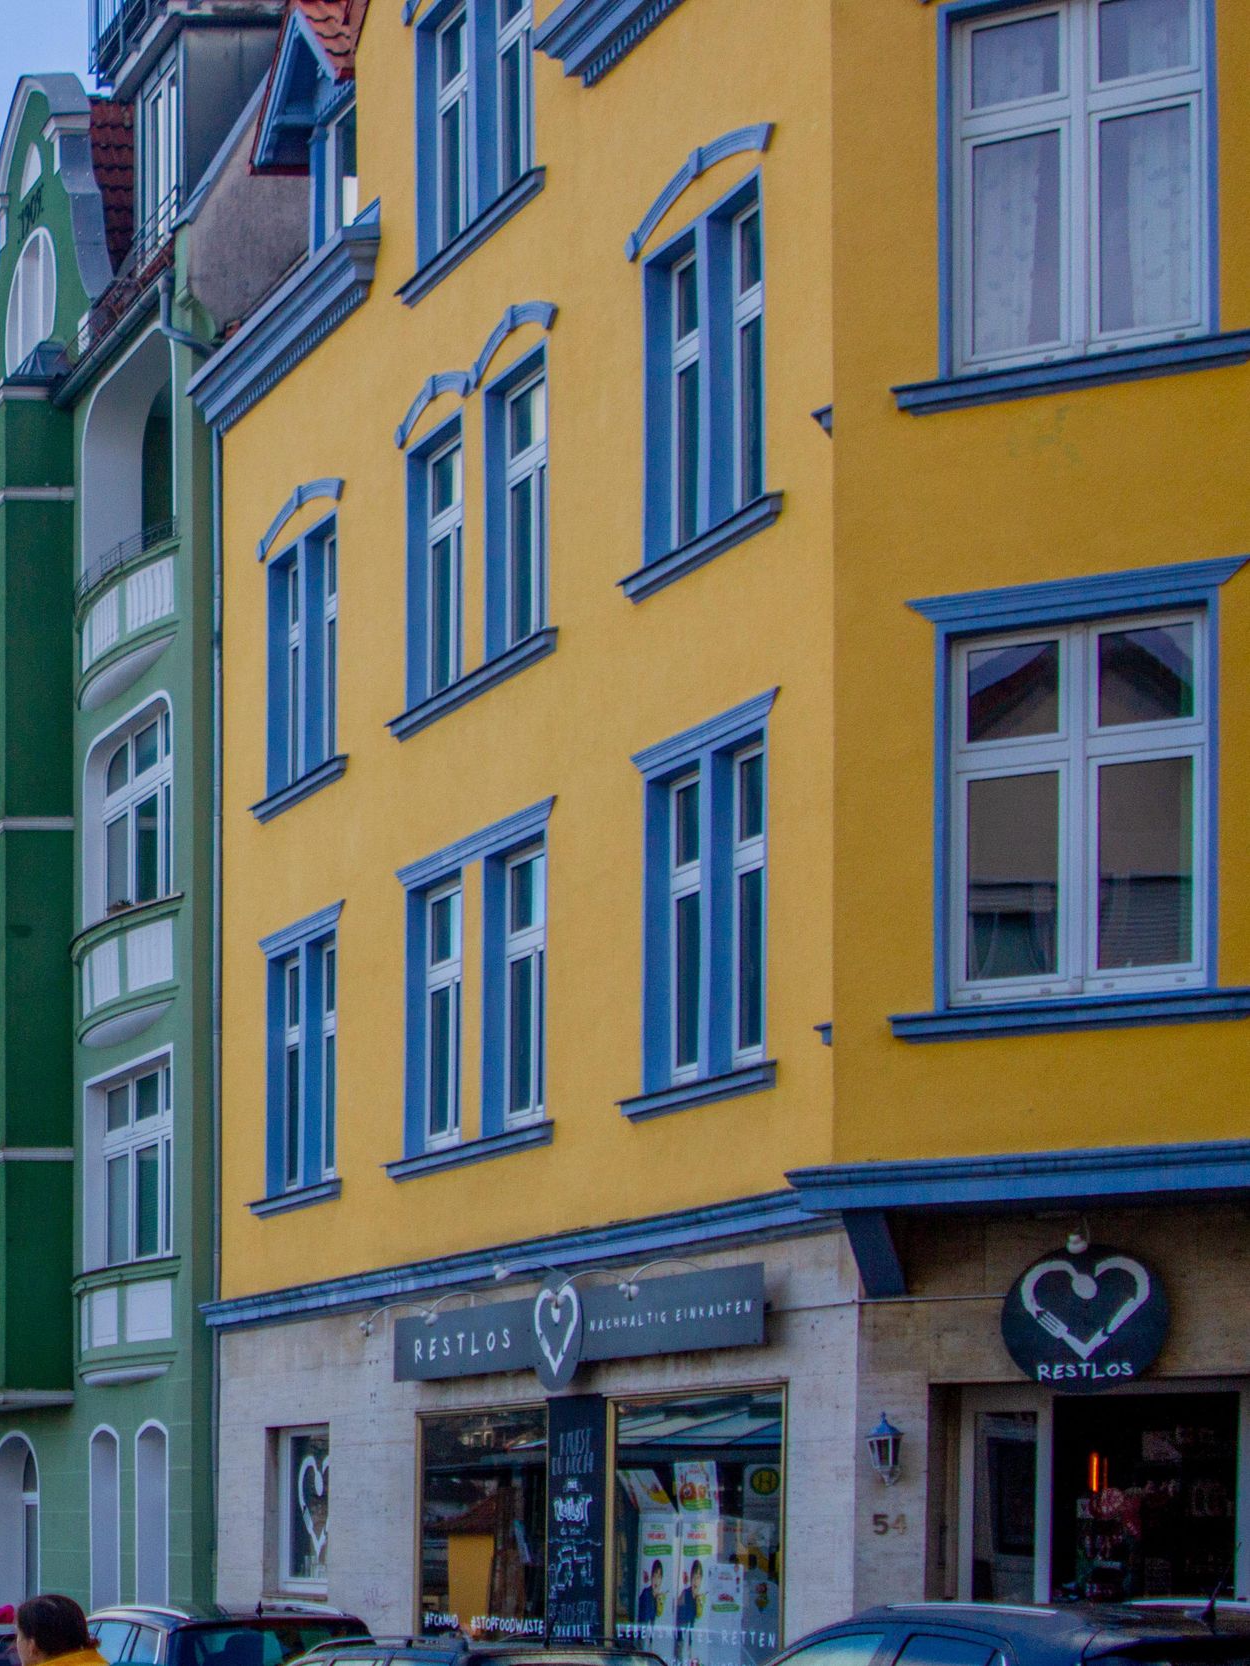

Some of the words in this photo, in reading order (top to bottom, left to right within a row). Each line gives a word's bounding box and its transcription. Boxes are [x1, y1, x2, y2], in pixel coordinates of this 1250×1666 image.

[589, 1311, 667, 1332] NACHHALTIG
[675, 1299, 753, 1322] EINKAUFEN
[414, 1328, 511, 1364] RESTLOS
[1037, 1361, 1134, 1382] RESTLOS
[872, 1513, 907, 1536] 54
[470, 1615, 545, 1636] #STOPFOODWASTE
[721, 1630, 776, 1649] RETTEN
